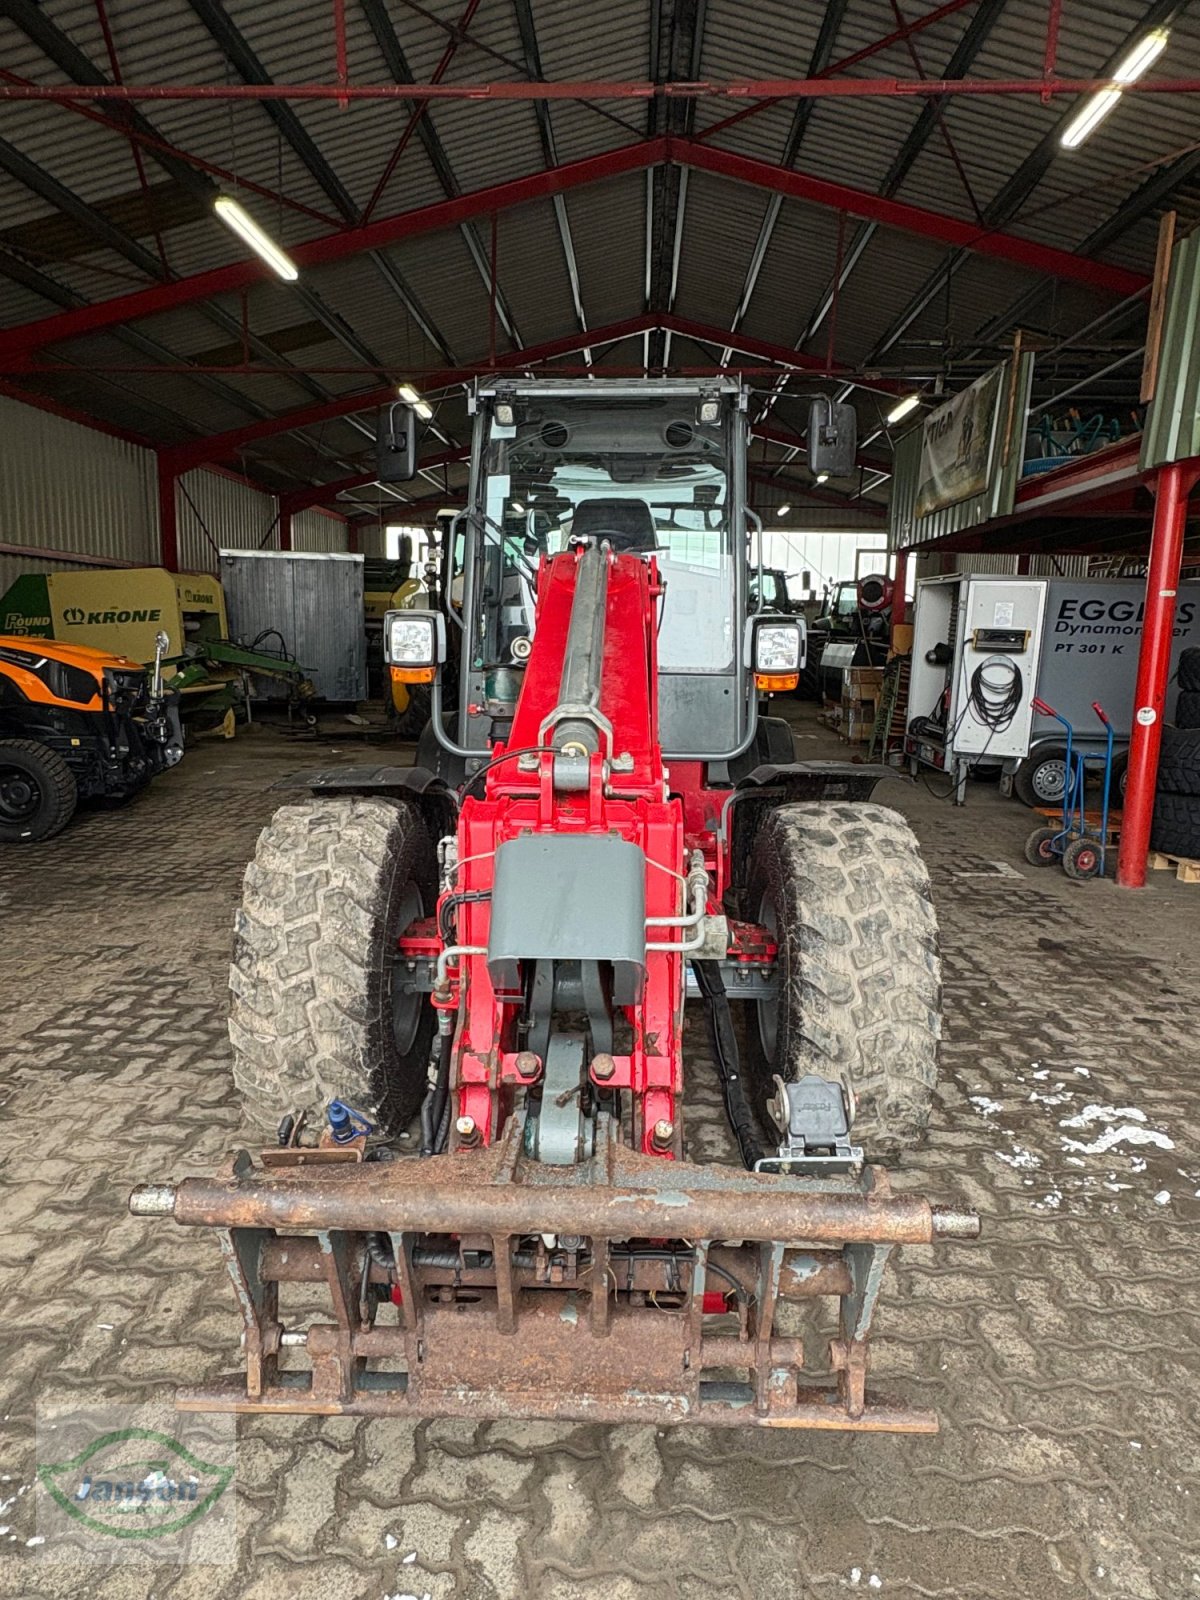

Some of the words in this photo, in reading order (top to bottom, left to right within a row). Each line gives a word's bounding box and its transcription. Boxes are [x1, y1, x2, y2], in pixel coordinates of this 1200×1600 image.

[87, 609, 161, 624] KRONE
[1054, 643, 1075, 653] PT
[1078, 644, 1106, 654] 301
[1111, 644, 1125, 655] K
